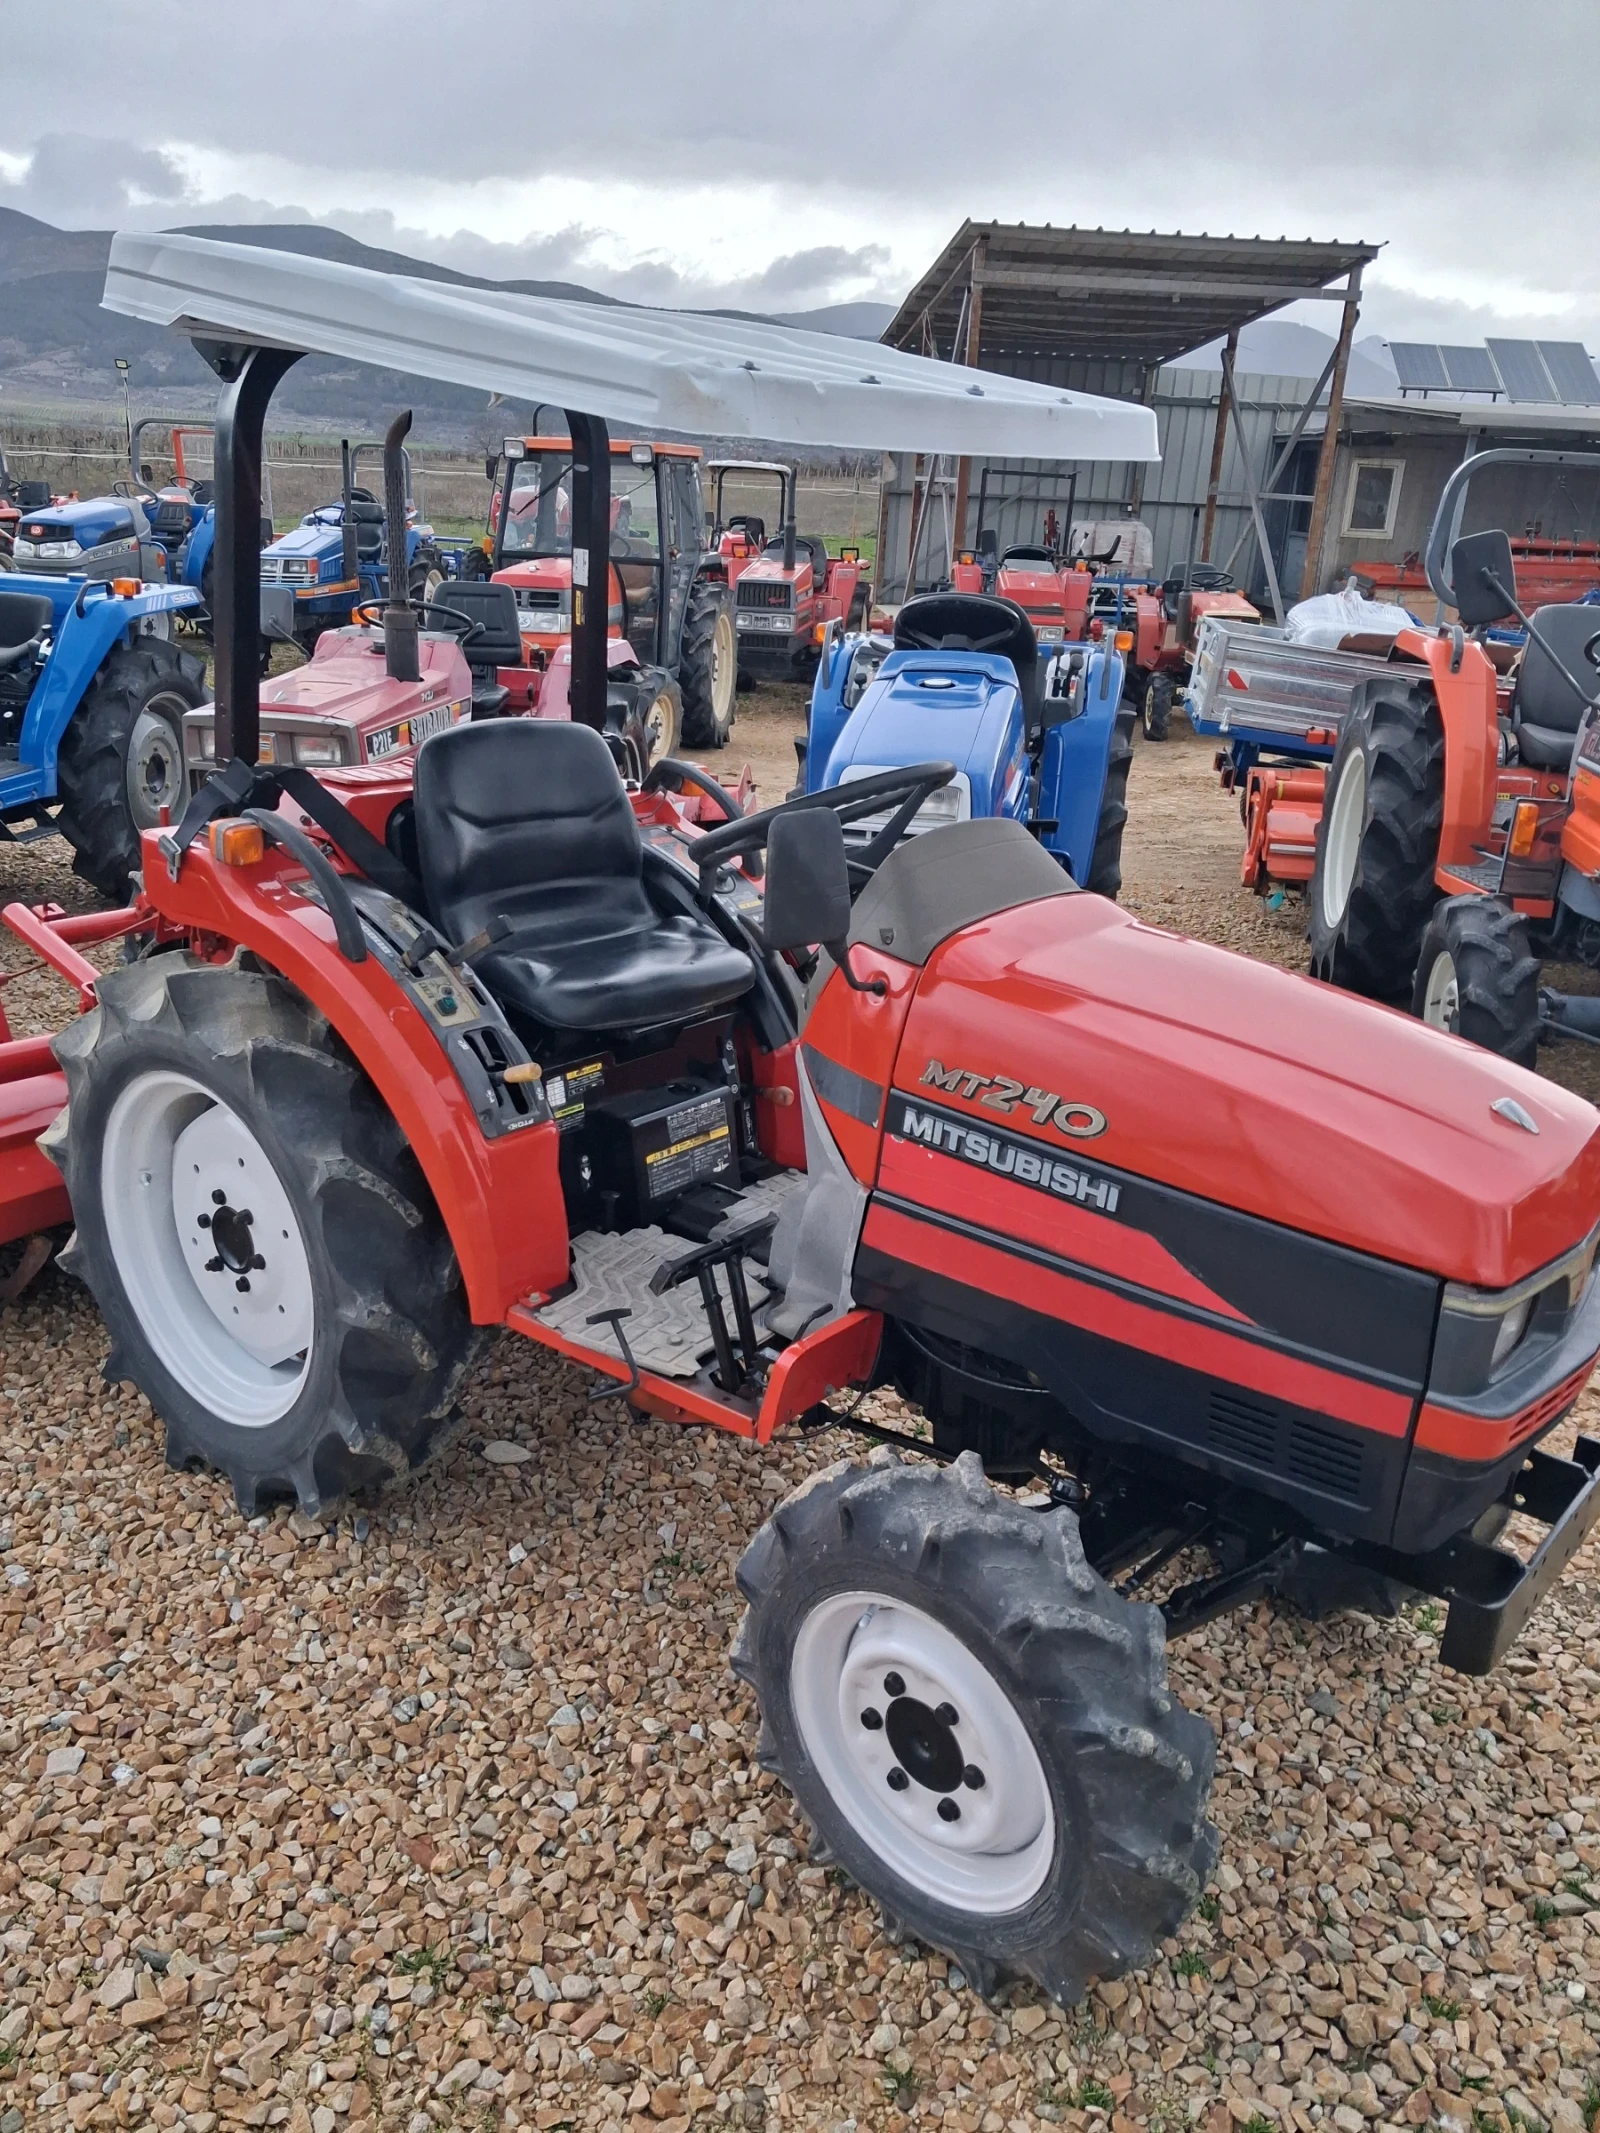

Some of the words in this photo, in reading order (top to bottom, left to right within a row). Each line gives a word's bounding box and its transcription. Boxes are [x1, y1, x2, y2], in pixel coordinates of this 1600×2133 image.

[170, 591, 198, 604] ISEKI
[919, 1059, 1108, 1138] MT240
[903, 1107, 1122, 1213] MITSUBISHI
